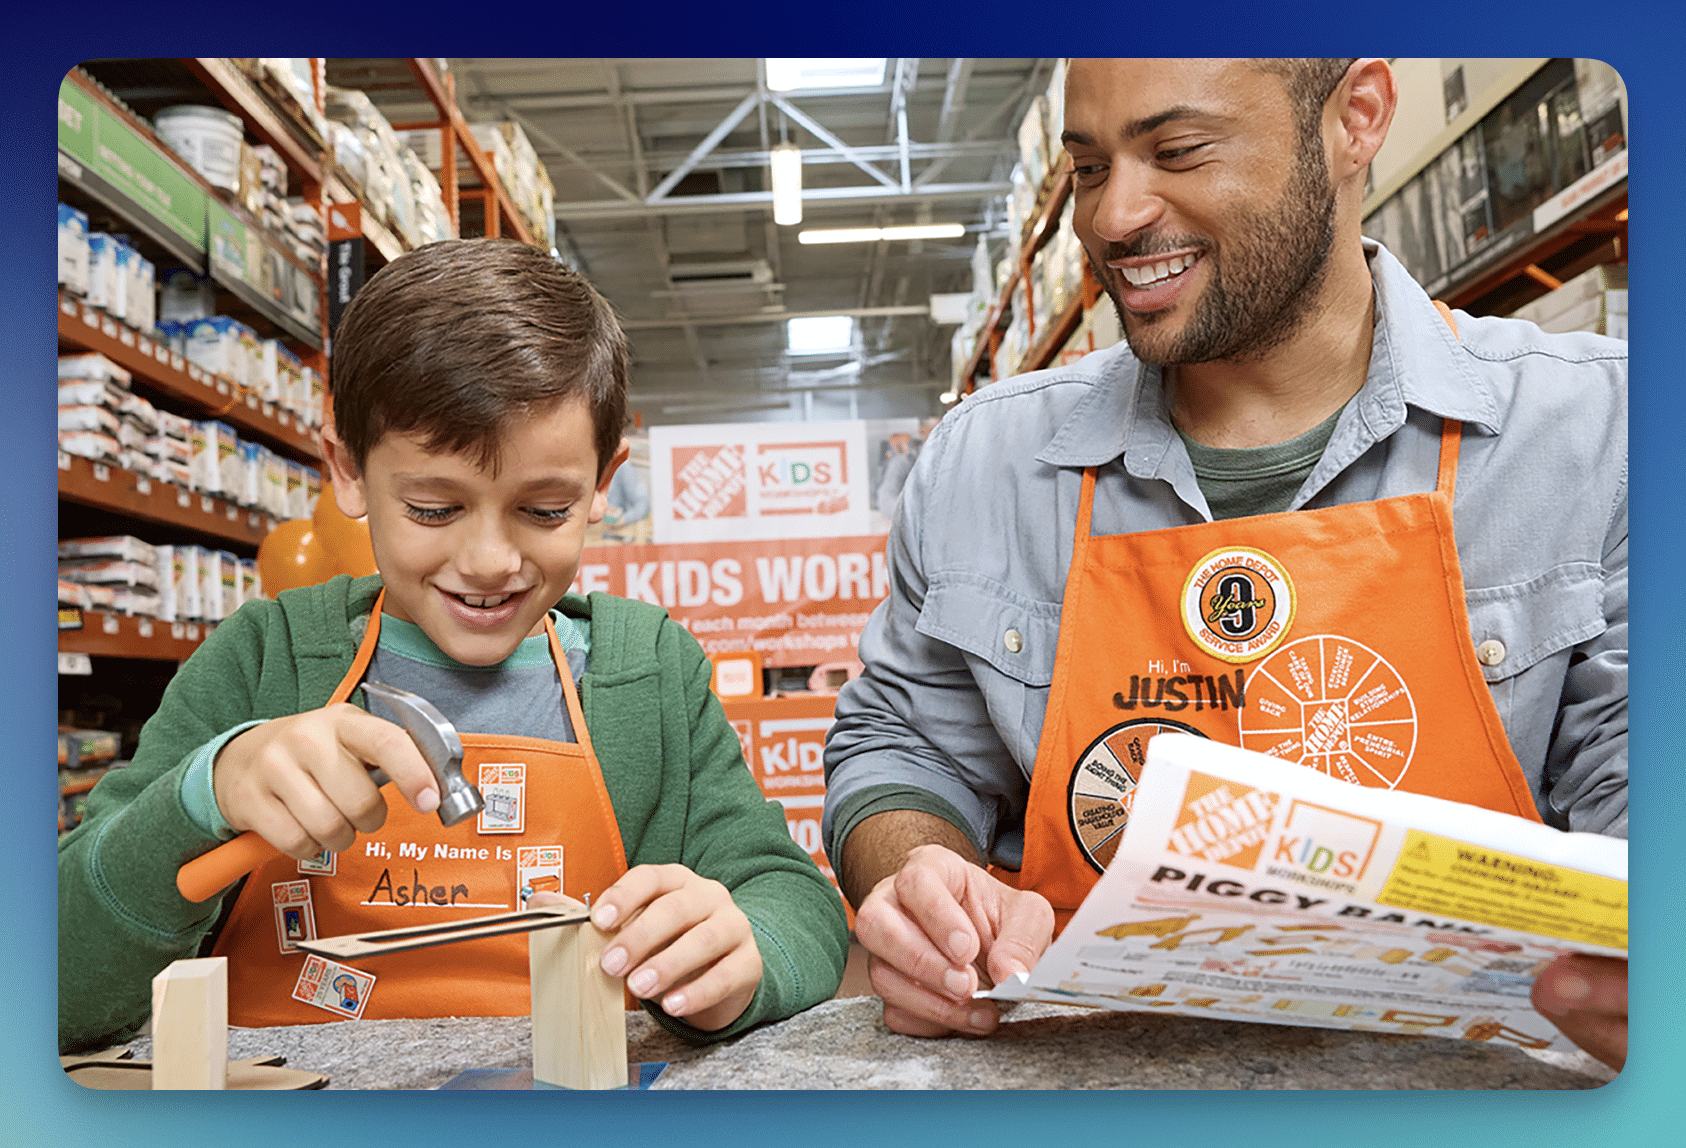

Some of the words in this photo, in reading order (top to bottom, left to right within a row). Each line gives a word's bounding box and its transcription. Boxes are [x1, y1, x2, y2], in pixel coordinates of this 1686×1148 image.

[672, 446, 745, 520] HOME
[758, 457, 833, 487] KIDS
[625, 558, 743, 607] KIDS
[1194, 568, 1212, 589] THE
[1210, 556, 1244, 573] HOME
[1245, 557, 1279, 583] DEPOT
[1208, 594, 1266, 623] Years
[1217, 573, 1257, 637] 9
[692, 616, 734, 633] each
[1199, 628, 1243, 653] SERVICE
[1248, 620, 1280, 652] AWARD
[1148, 660, 1169, 675] Hi,
[1173, 660, 1191, 673] I'm
[1112, 669, 1246, 712] JUSTIN
[1258, 697, 1287, 713] GIVING
[1349, 687, 1406, 722] RELATIONSHIPS
[1259, 705, 1281, 718] BACK
[1305, 702, 1346, 754] HOME
[1308, 706, 1327, 729] THE
[1322, 719, 1348, 752] DEPOT
[760, 737, 824, 775] KID
[1187, 785, 1230, 817] THE
[1168, 789, 1273, 856] HOME
[366, 842, 392, 860] Hi,
[399, 843, 428, 861] My
[434, 844, 489, 860] Name
[496, 846, 512, 860] Is
[1204, 824, 1271, 865] DEPOT
[1274, 835, 1359, 878] KIDS
[368, 868, 469, 907] Asher
[1150, 865, 1331, 910] PIGGY
[1265, 864, 1356, 893] WORKSHOPS
